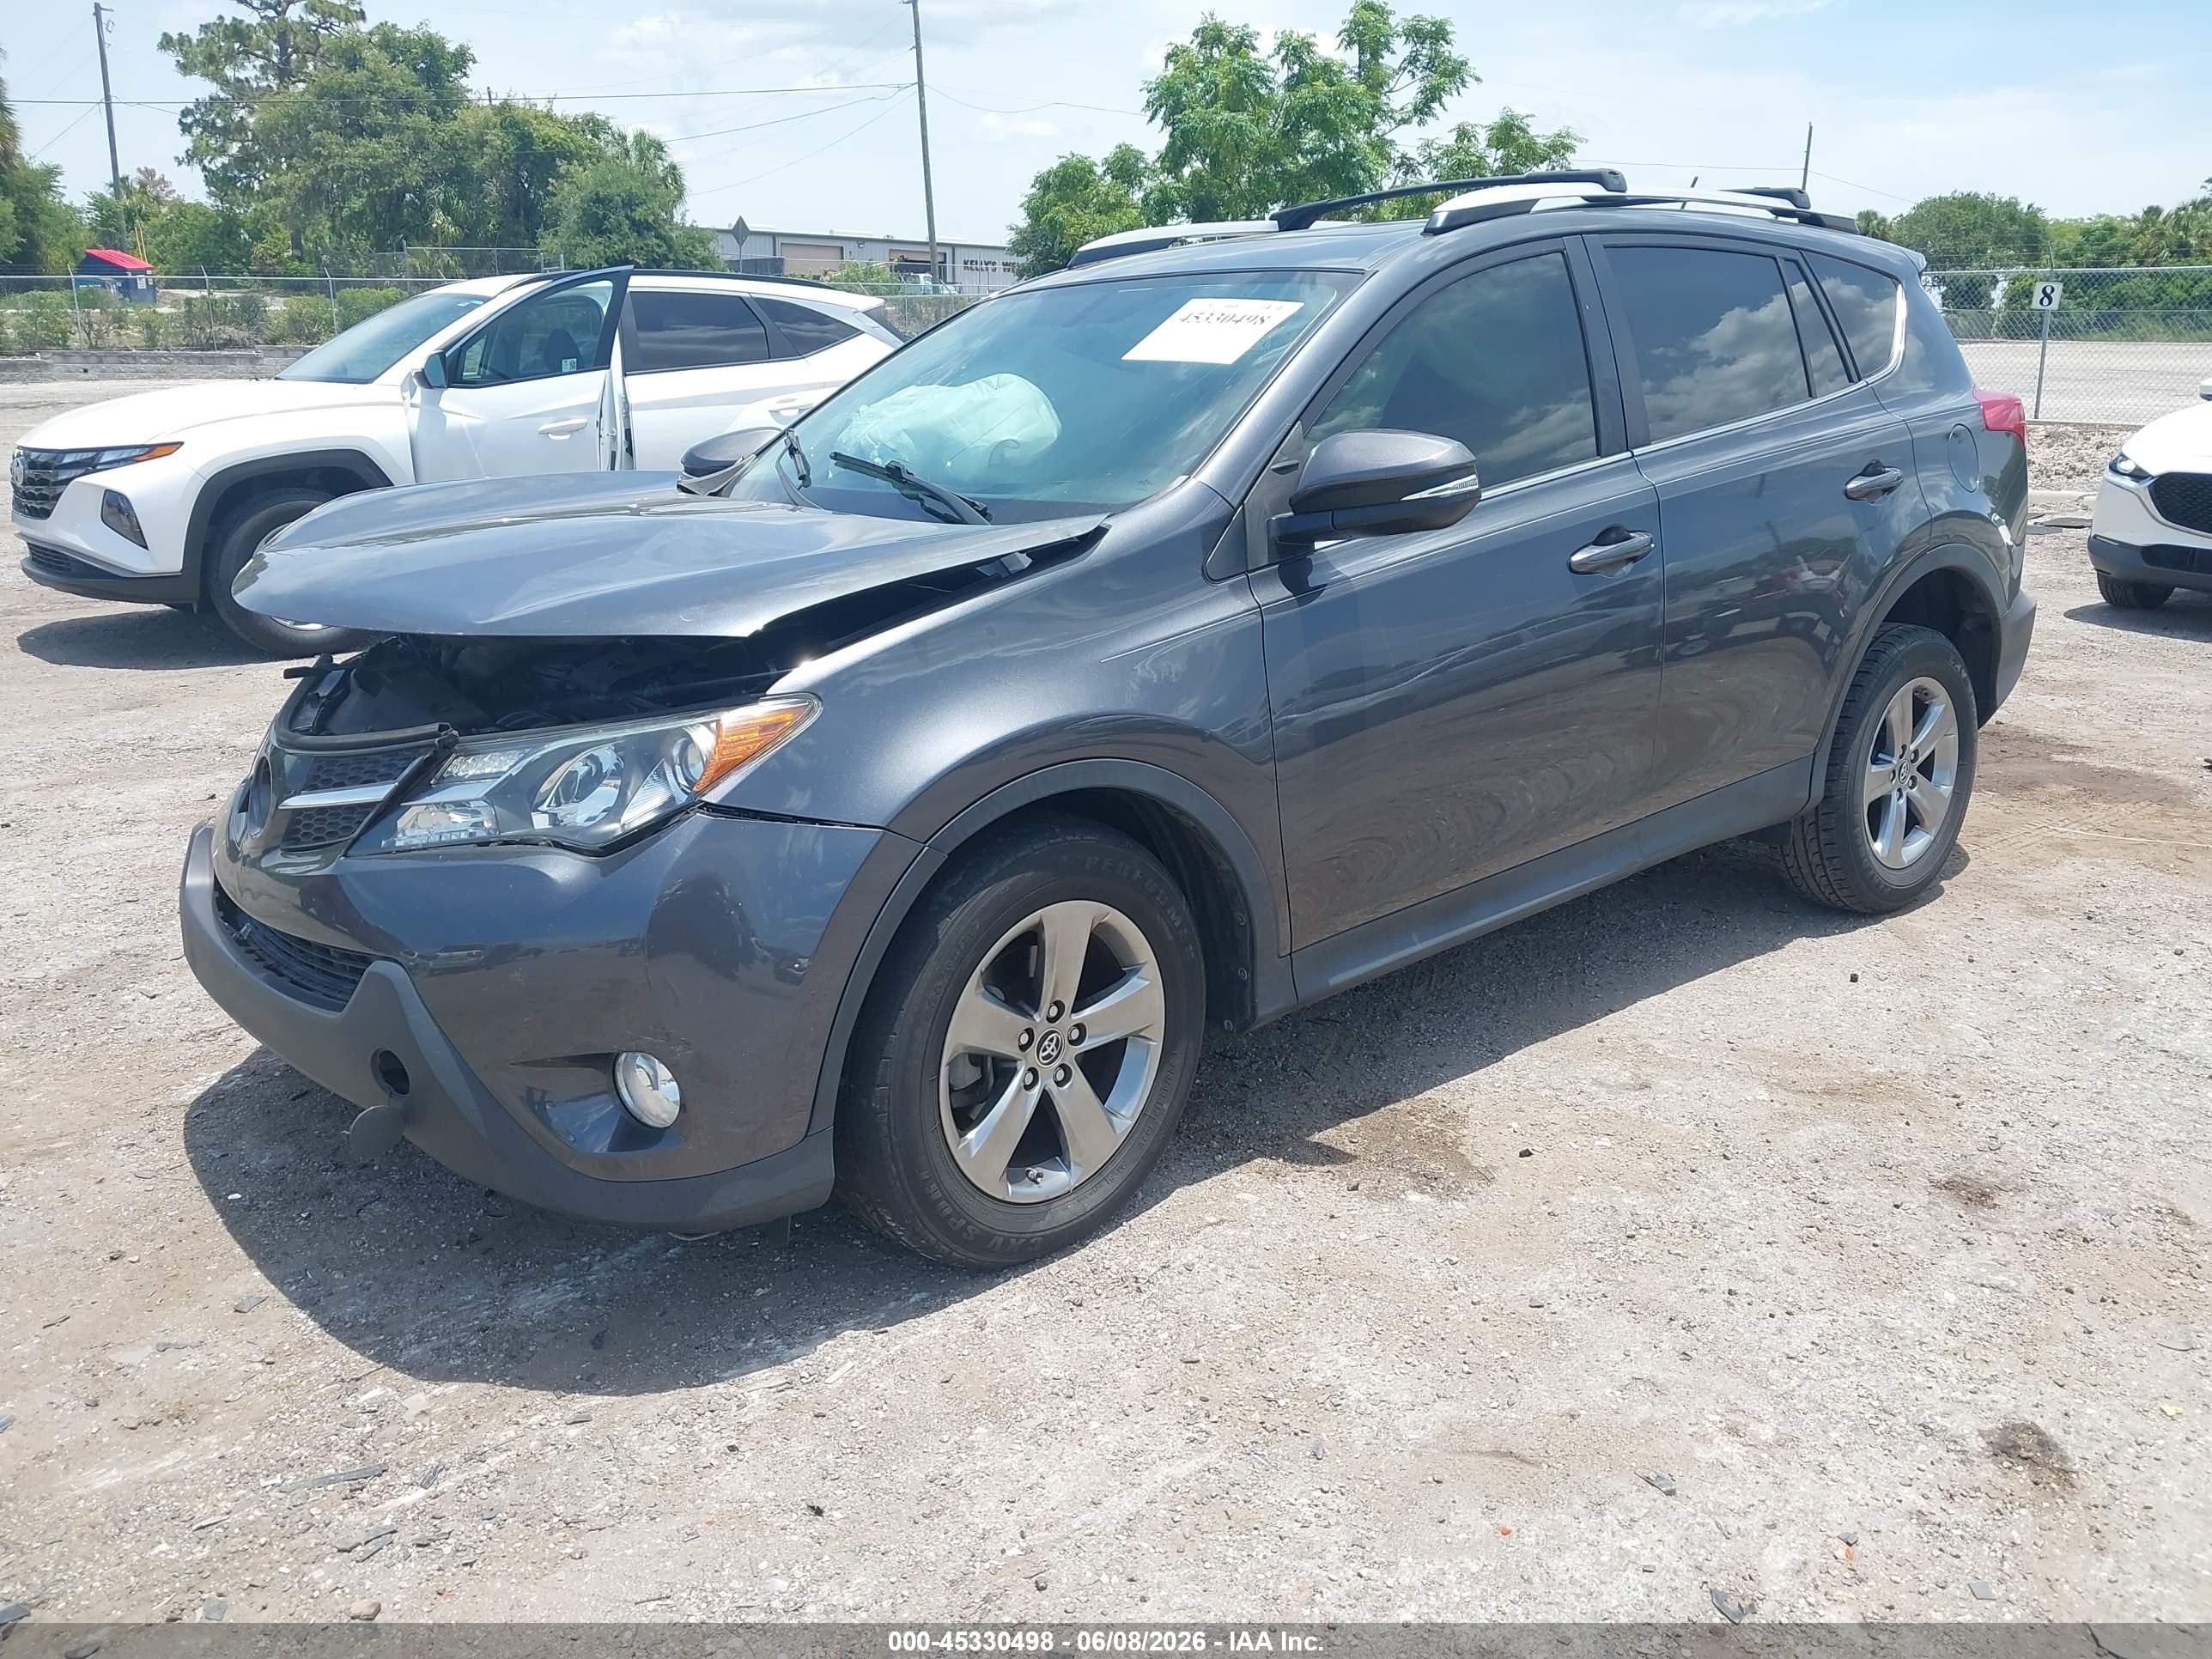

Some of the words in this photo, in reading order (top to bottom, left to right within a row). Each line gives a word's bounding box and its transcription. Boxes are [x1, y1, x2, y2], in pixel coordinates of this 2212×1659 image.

[963, 259, 997, 272] KELLY'S
[2039, 284, 2056, 307] 8
[1178, 311, 1272, 325] 45330498
